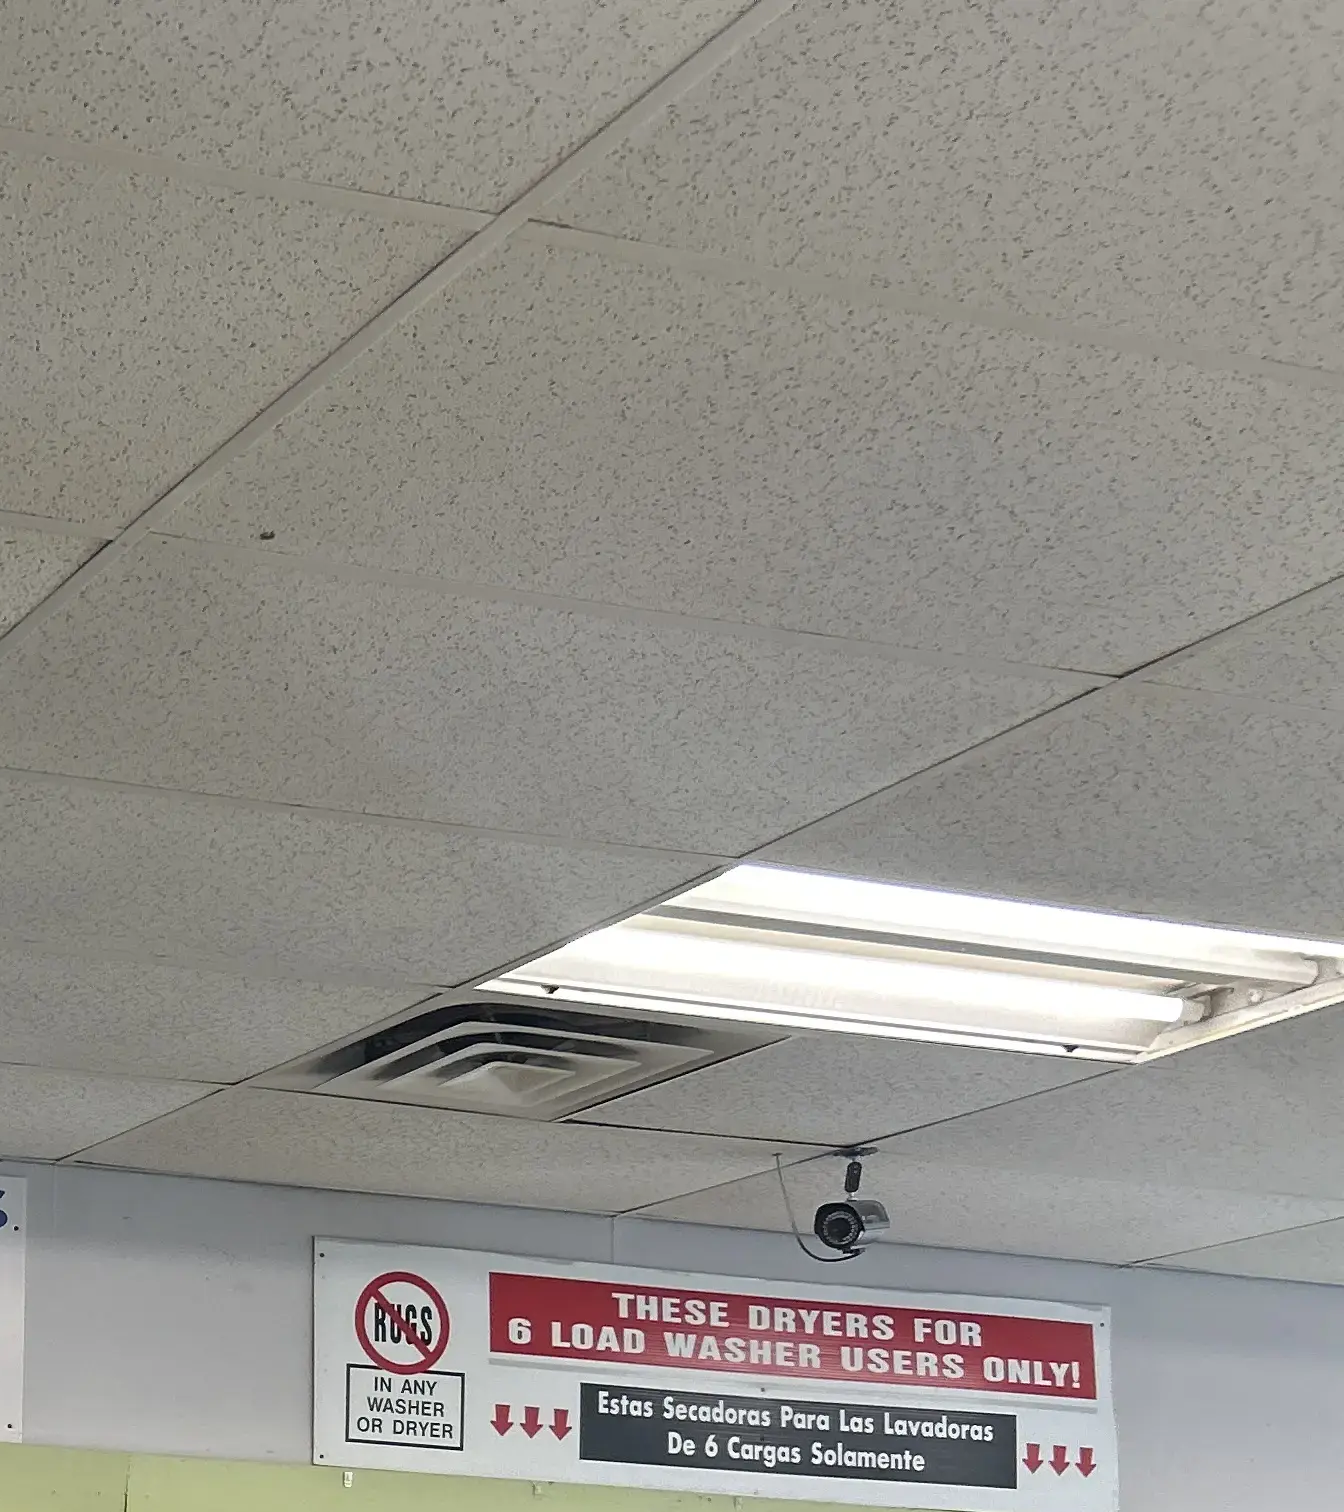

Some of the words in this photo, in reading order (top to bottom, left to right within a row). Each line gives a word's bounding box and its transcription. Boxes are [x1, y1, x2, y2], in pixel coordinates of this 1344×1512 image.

[373, 1303, 434, 1346] RUGS
[611, 1292, 730, 1328] THESE
[748, 1305, 895, 1341] DRYERS
[913, 1318, 982, 1347] FOR
[508, 1317, 532, 1345] 6
[551, 1321, 646, 1354] LOAD
[663, 1331, 822, 1371] WASHER
[840, 1346, 965, 1380] USERS
[983, 1356, 1081, 1389] ONLY!
[366, 1396, 445, 1418] WASHER
[374, 1376, 392, 1393] IN
[400, 1378, 438, 1396] ANY
[356, 1416, 383, 1434] OR
[392, 1419, 453, 1439] DRYER
[598, 1390, 654, 1418] Estas
[662, 1396, 771, 1427] Secadoras
[780, 1405, 830, 1431] Para
[839, 1409, 875, 1434] Las
[884, 1411, 994, 1442] Lavadoras
[667, 1431, 696, 1456] De
[704, 1434, 719, 1458] 6
[727, 1436, 801, 1468] Cargas
[811, 1441, 926, 1472] Solamente
